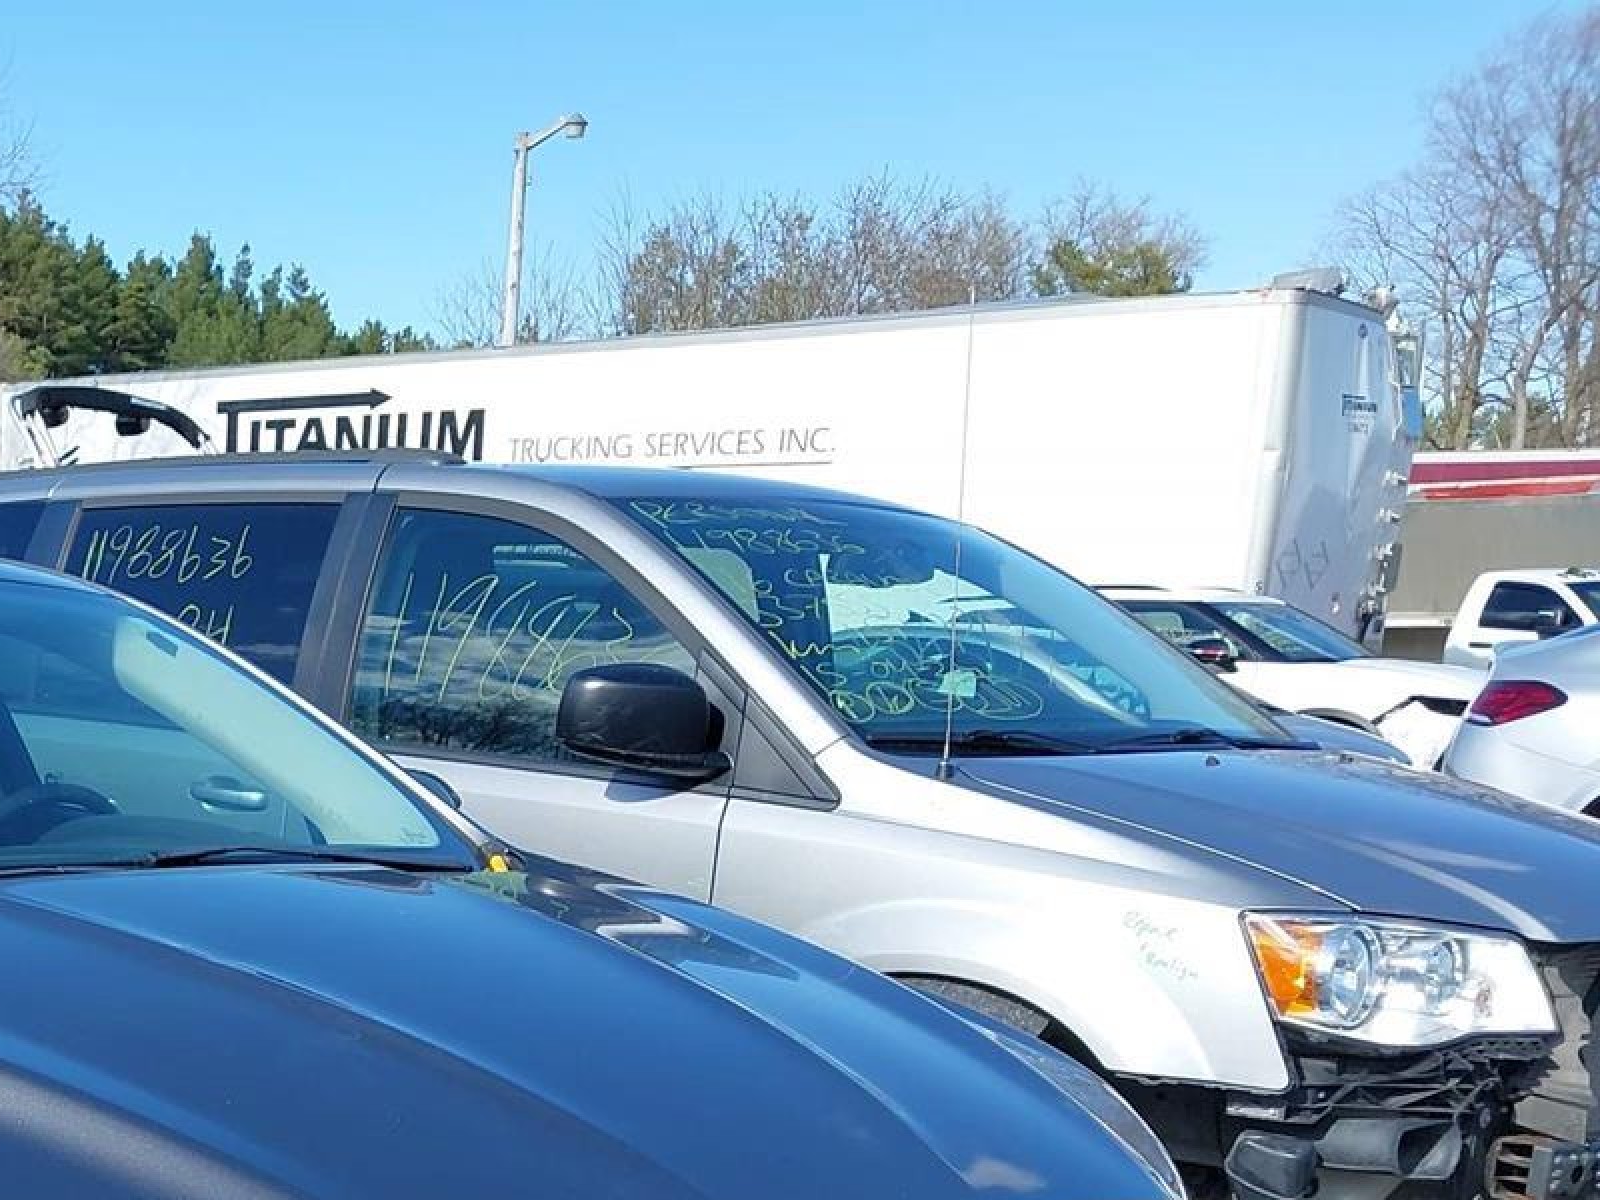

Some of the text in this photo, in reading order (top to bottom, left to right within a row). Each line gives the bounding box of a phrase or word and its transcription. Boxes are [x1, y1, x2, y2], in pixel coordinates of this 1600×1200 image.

[218, 388, 836, 463] TITANIUM TRUCKING SERVICES INC.
